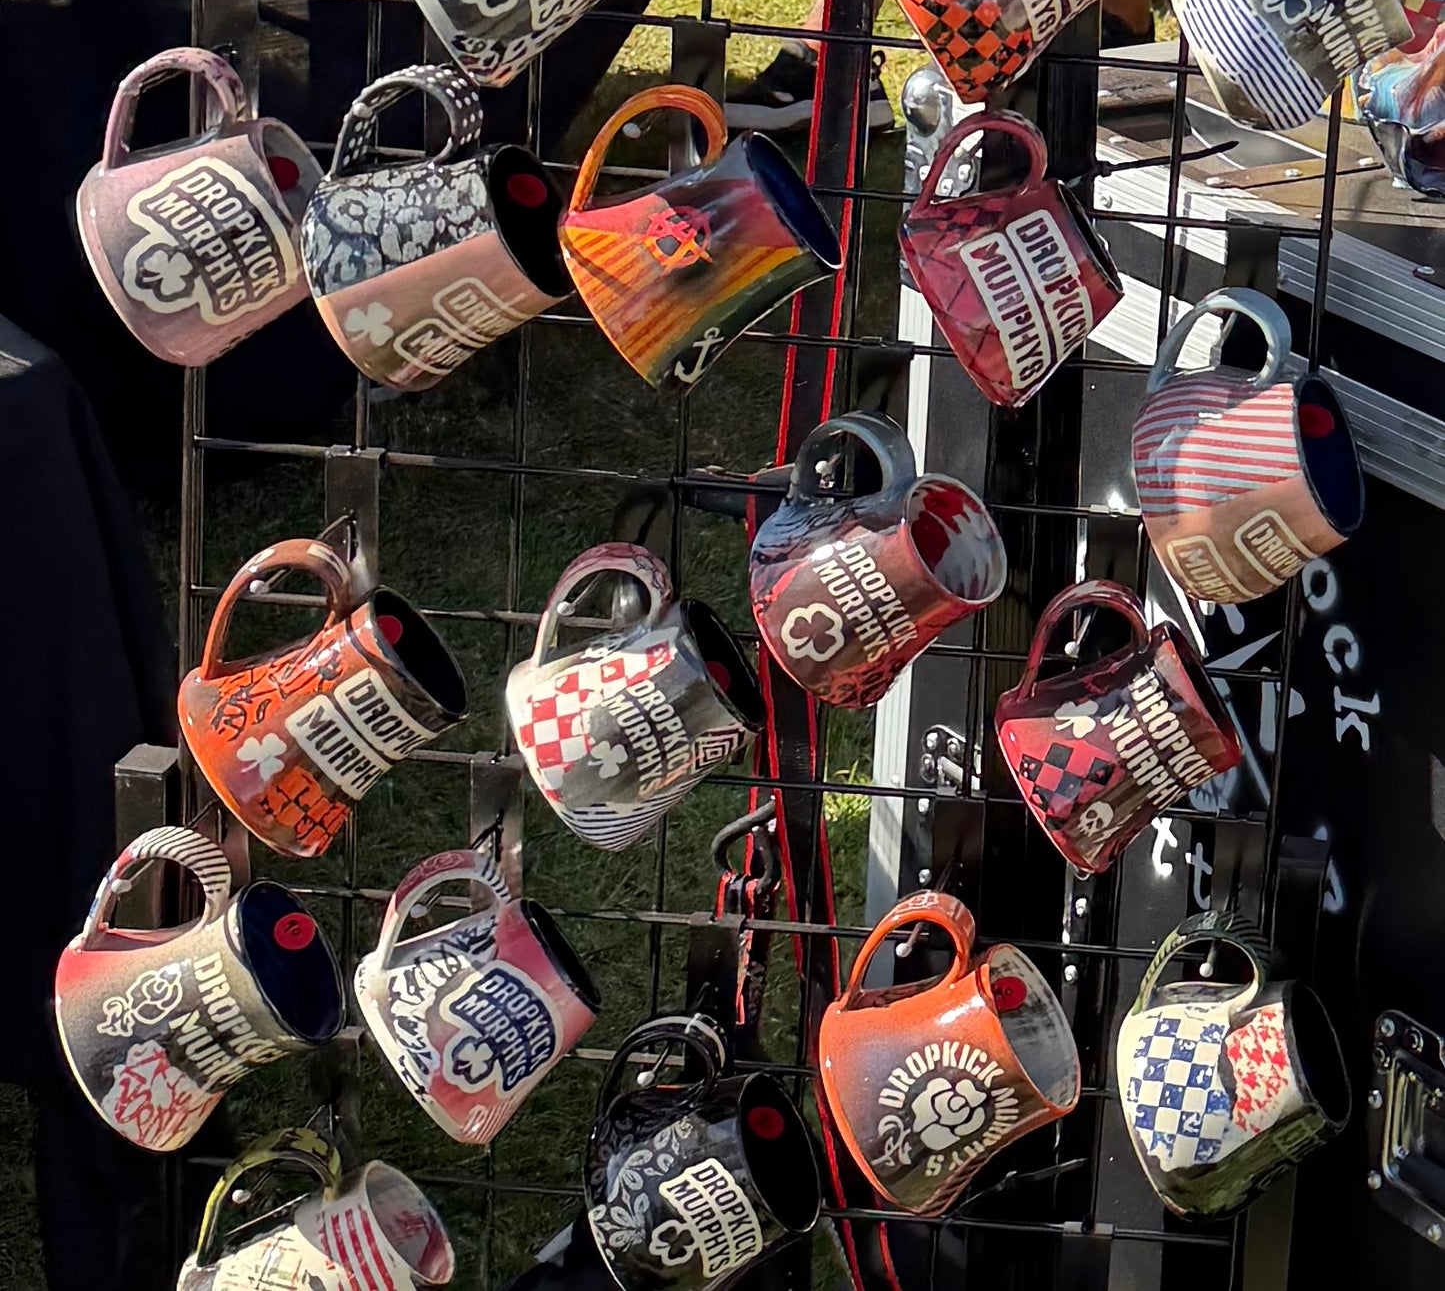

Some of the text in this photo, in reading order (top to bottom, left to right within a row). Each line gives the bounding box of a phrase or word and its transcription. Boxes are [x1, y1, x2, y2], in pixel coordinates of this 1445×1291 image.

[147, 192, 247, 311] MURPHYS
[177, 171, 281, 298] DROPKICK
[970, 240, 1044, 381] MURPHYS
[1016, 217, 1088, 355] DROPKICK
[813, 560, 891, 662] MURPHYS
[839, 544, 918, 650] DROPKICK
[296, 705, 385, 793] MURPH
[456, 994, 527, 1086] MURPHYS
[477, 974, 551, 1072] DROPKICK
[878, 1040, 1005, 1109] DROPKICK
[666, 1179, 731, 1274] MURPHYS
[691, 1165, 757, 1263] DROPKICK
